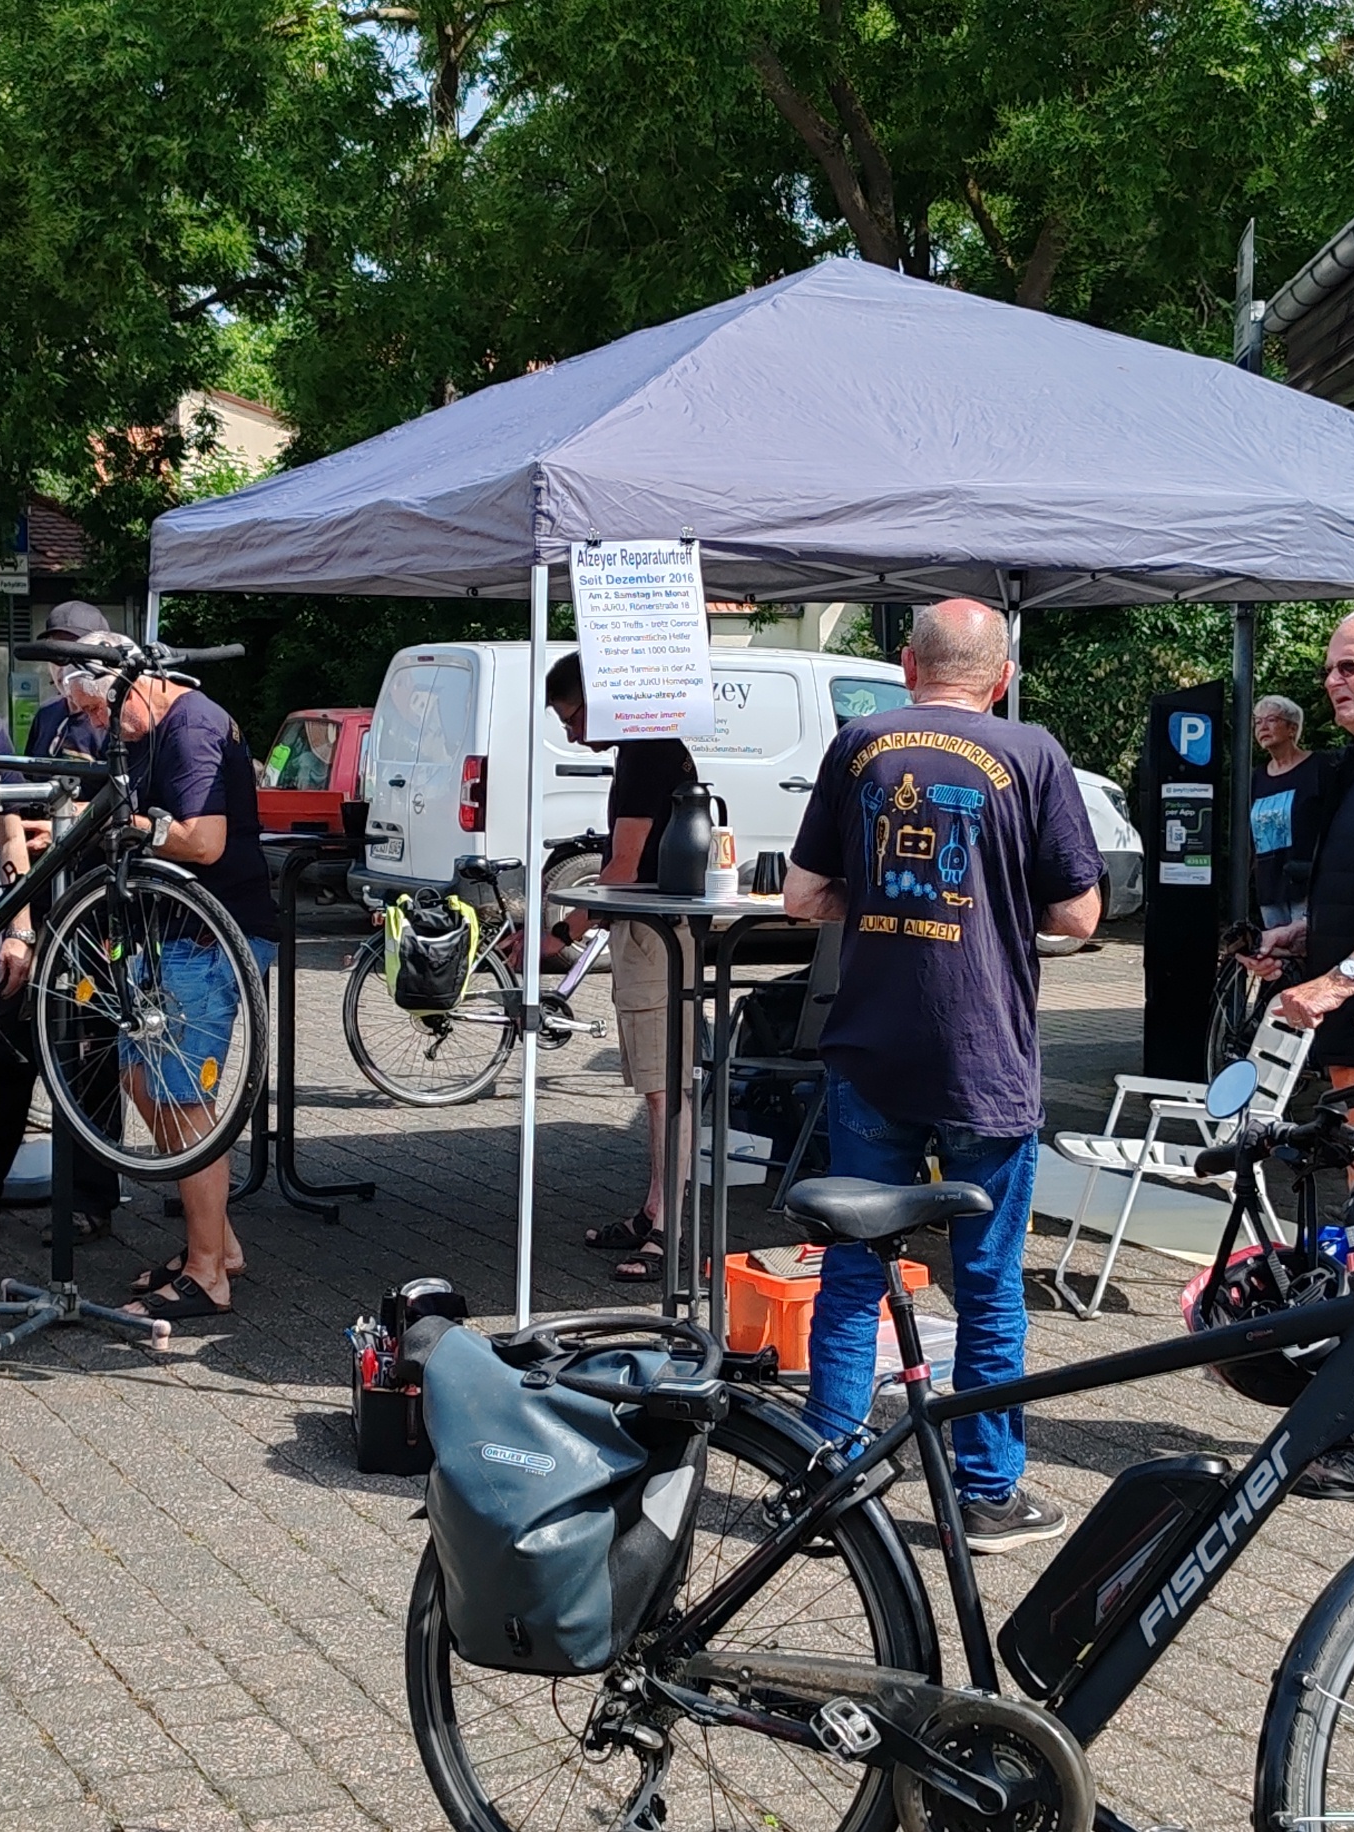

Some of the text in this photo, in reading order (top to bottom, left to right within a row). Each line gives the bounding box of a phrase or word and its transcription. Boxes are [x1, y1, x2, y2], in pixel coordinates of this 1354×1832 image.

[577, 546, 693, 571] Alzeyer Reparaturtreff
[579, 572, 694, 586] Seit Dezember 2016
[588, 592, 602, 600] Am
[614, 591, 651, 600] Samstag
[665, 590, 689, 598] Monat
[631, 647, 646, 655] fast
[648, 646, 667, 654] 1000
[671, 664, 683, 672] der
[592, 680, 607, 688] und
[623, 679, 636, 687] der
[638, 678, 661, 687] JUKU
[713, 681, 752, 709] zey
[660, 710, 686, 719] immer
[1180, 717, 1205, 755] P
[850, 732, 1011, 790] REPARATURTREFF
[903, 920, 961, 942] ALZEY
